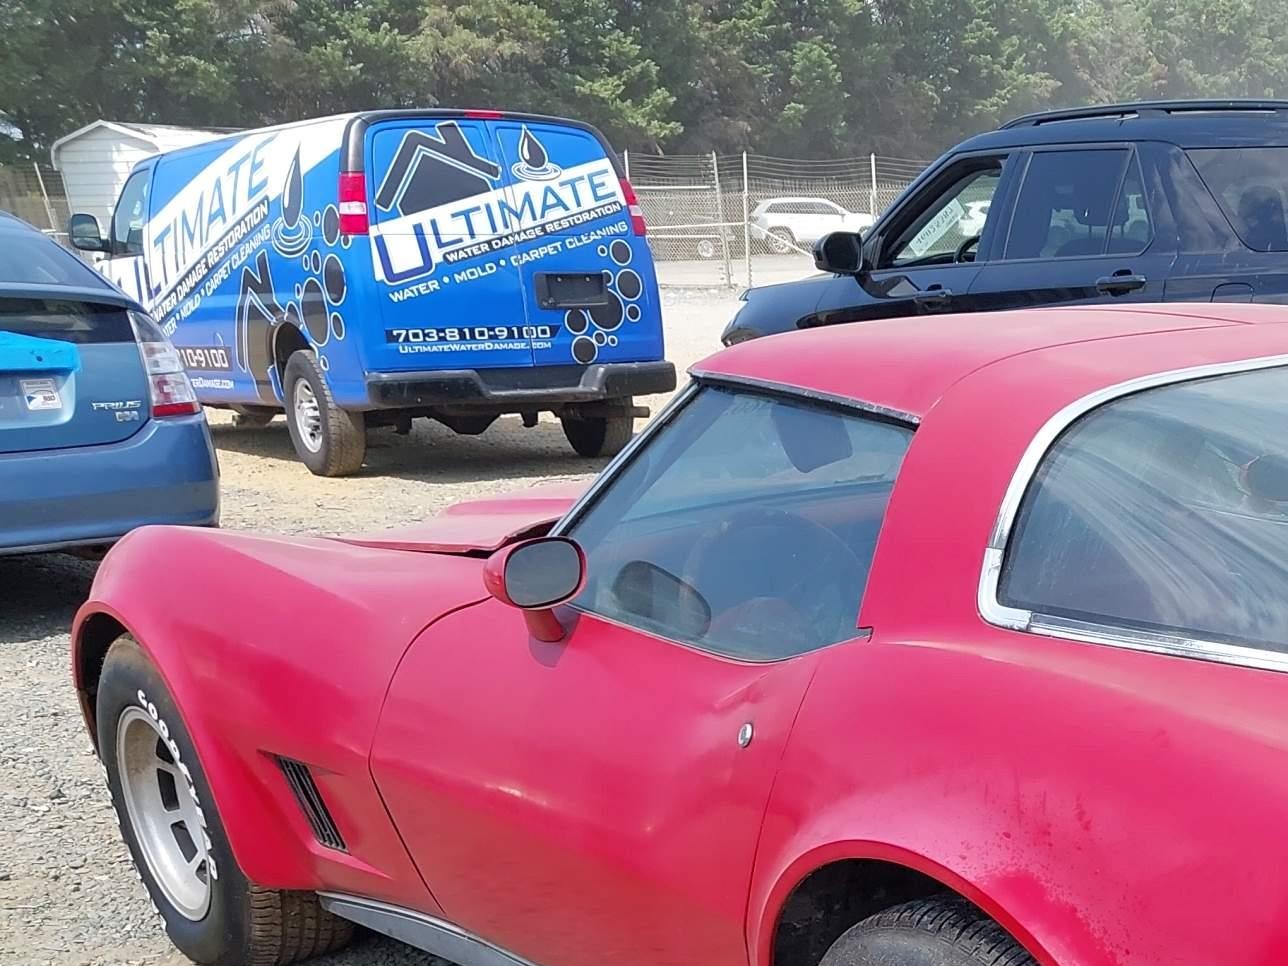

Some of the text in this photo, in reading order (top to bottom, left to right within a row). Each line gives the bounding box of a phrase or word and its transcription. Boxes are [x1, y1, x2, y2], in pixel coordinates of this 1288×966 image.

[176, 257, 209, 299] DAMAGE
[206, 199, 269, 269] RESTORATION
[374, 168, 617, 282] ULTIMATE
[446, 202, 622, 263] WATER DAMAGE RESTORATION
[180, 294, 201, 320] MOLD
[205, 259, 232, 297] CARPET
[231, 223, 271, 271] CLEANING
[389, 220, 629, 303] WATER MOLD CARPET CLEANING
[176, 348, 229, 368] 10-9100
[392, 325, 551, 343] 703-810-9100
[91, 400, 142, 410] PRIUS
